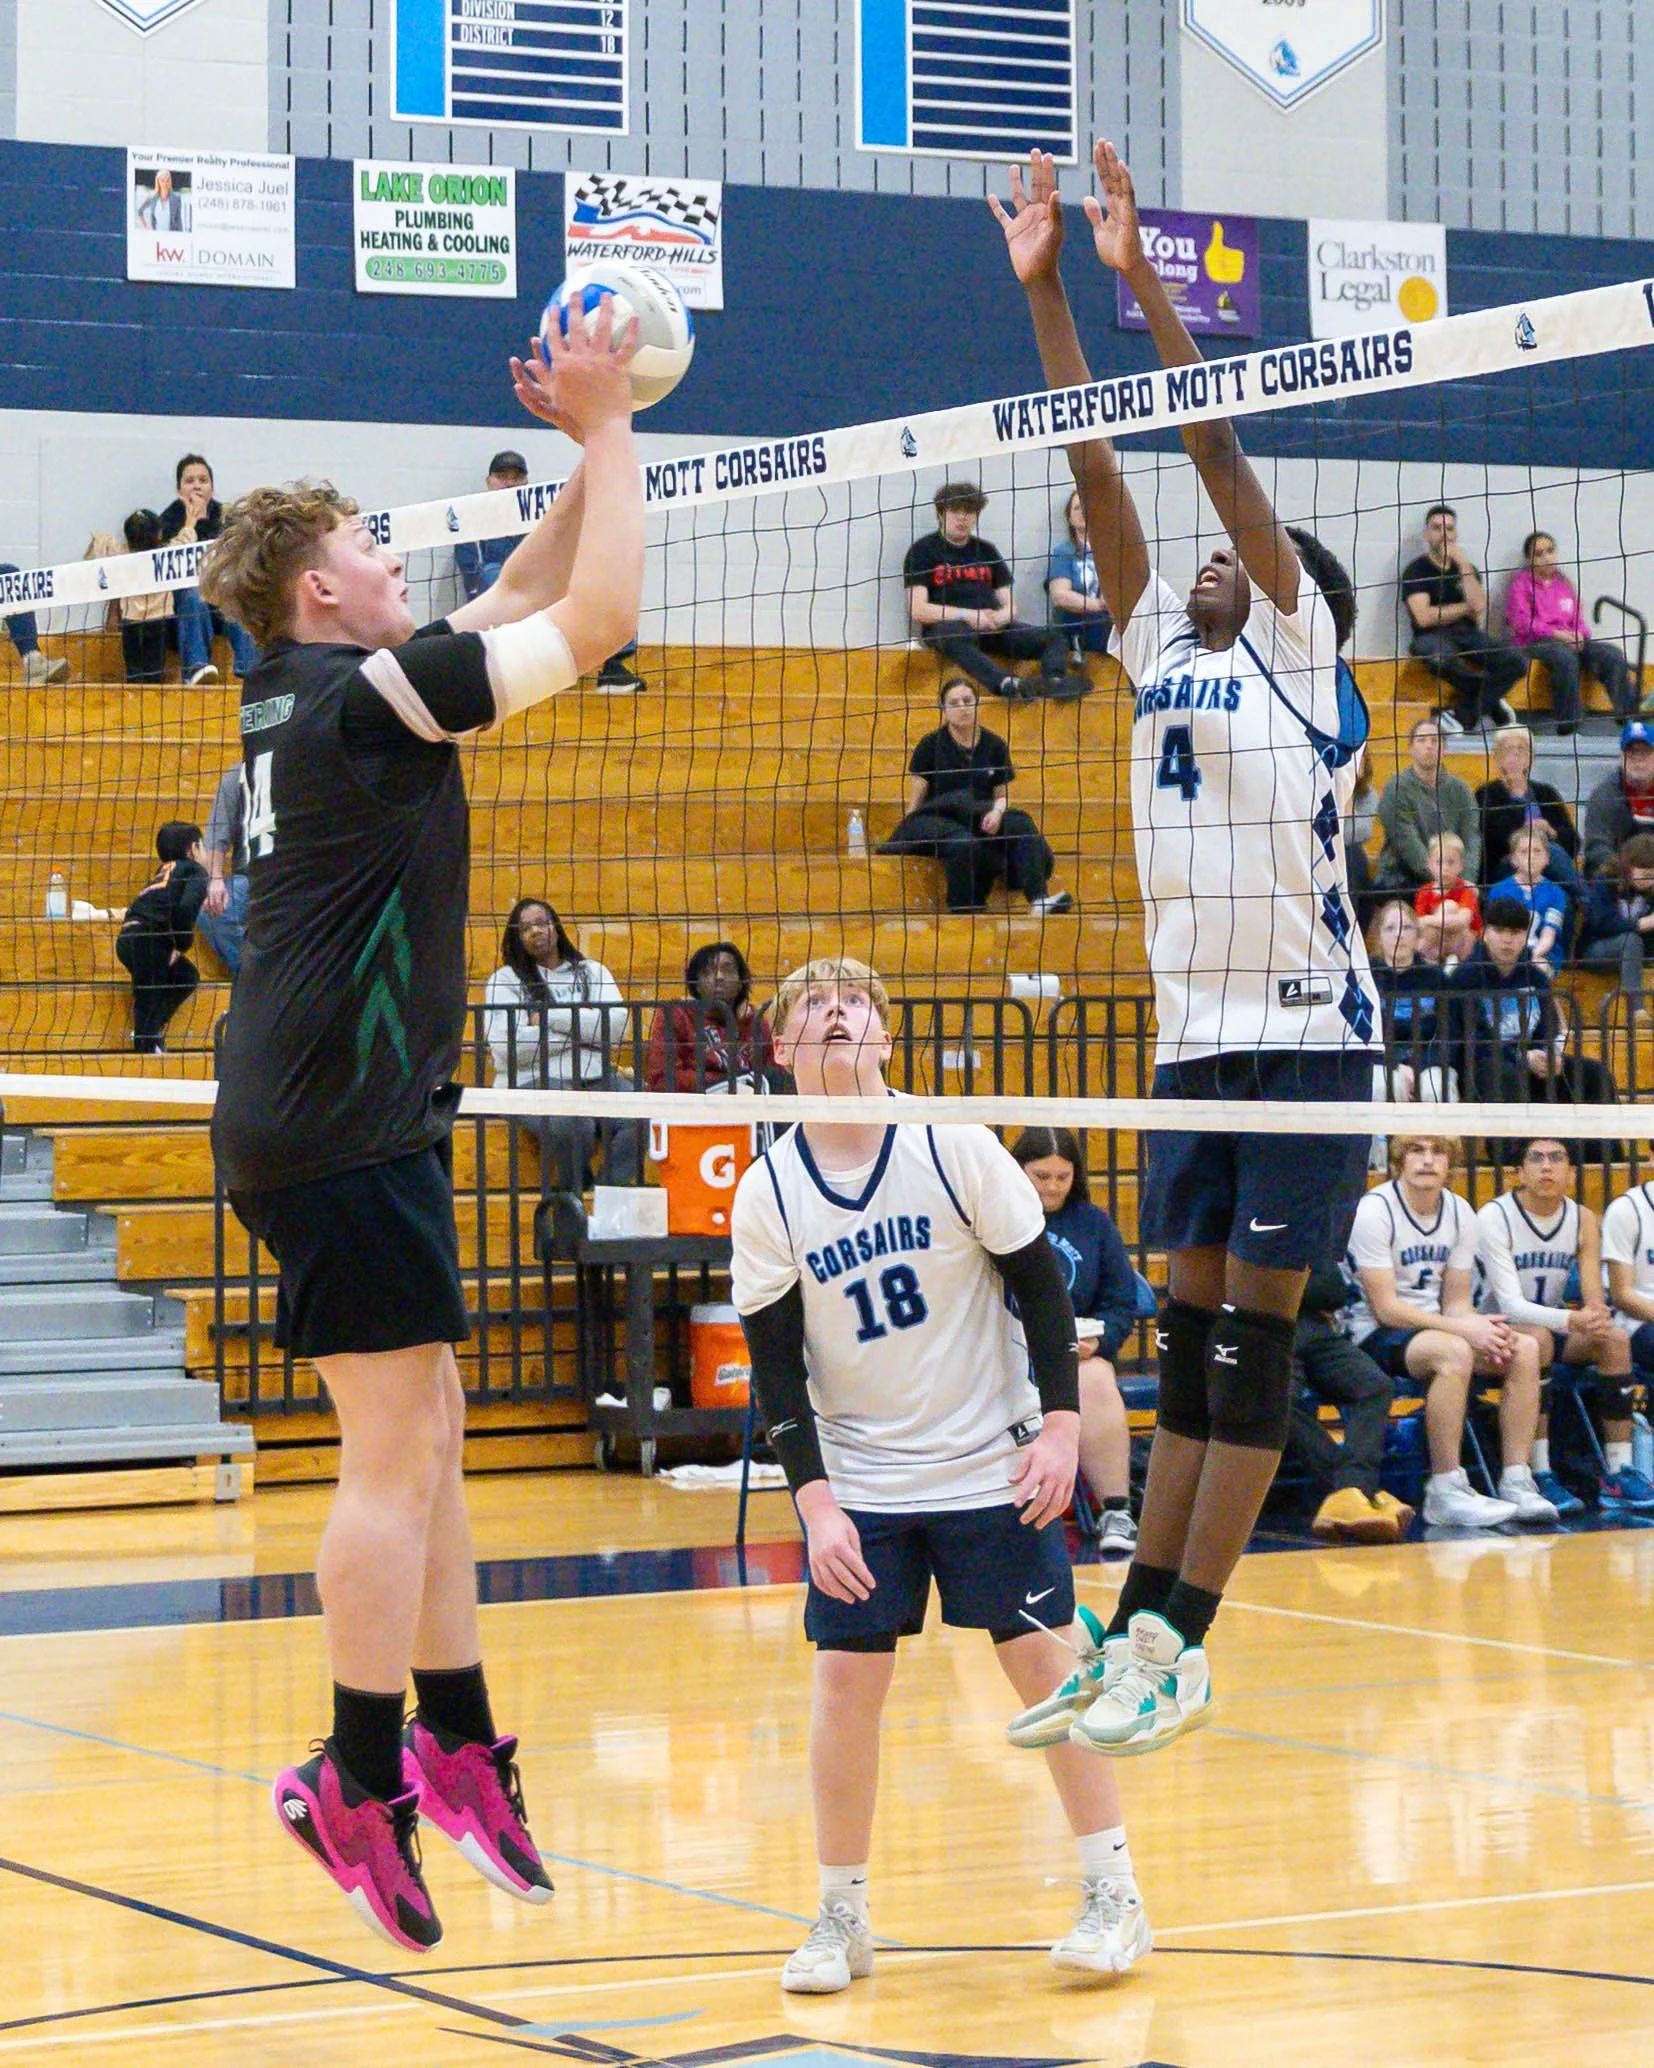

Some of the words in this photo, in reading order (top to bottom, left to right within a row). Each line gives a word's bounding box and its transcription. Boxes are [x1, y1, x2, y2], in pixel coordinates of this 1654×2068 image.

[462, 0, 515, 20] DIVISION
[461, 24, 514, 46] DISTRICT
[131, 151, 154, 162] Your
[156, 153, 194, 164] Premier
[197, 155, 227, 169] Realty
[230, 159, 290, 170] Professional
[196, 177, 253, 194] Jessica
[258, 180, 289, 195] Juel
[361, 171, 424, 203] LAKE
[428, 174, 508, 206] ORION
[395, 209, 474, 230] PLUMBING
[198, 249, 274, 268] DOMAIN
[360, 230, 423, 251] HEATING
[427, 233, 439, 252] &
[443, 235, 510, 254] COOLING
[1138, 226, 1198, 260] You
[1317, 239, 1436, 272] Clarkston
[1320, 271, 1391, 312] Legal
[992, 377, 1154, 442] WATERFORD
[1166, 359, 1247, 412] MOTT
[1260, 329, 1413, 396] CORSAIRS
[516, 482, 566, 521] WAT
[646, 458, 705, 502] MOTT
[715, 436, 828, 490] CORSAIRS
[1156, 723, 1202, 801] 4
[699, 1143, 736, 1190] G
[804, 1214, 933, 1285] CORSAIRS
[842, 1262, 930, 1344] 18
[1534, 1275, 1547, 1305] 1
